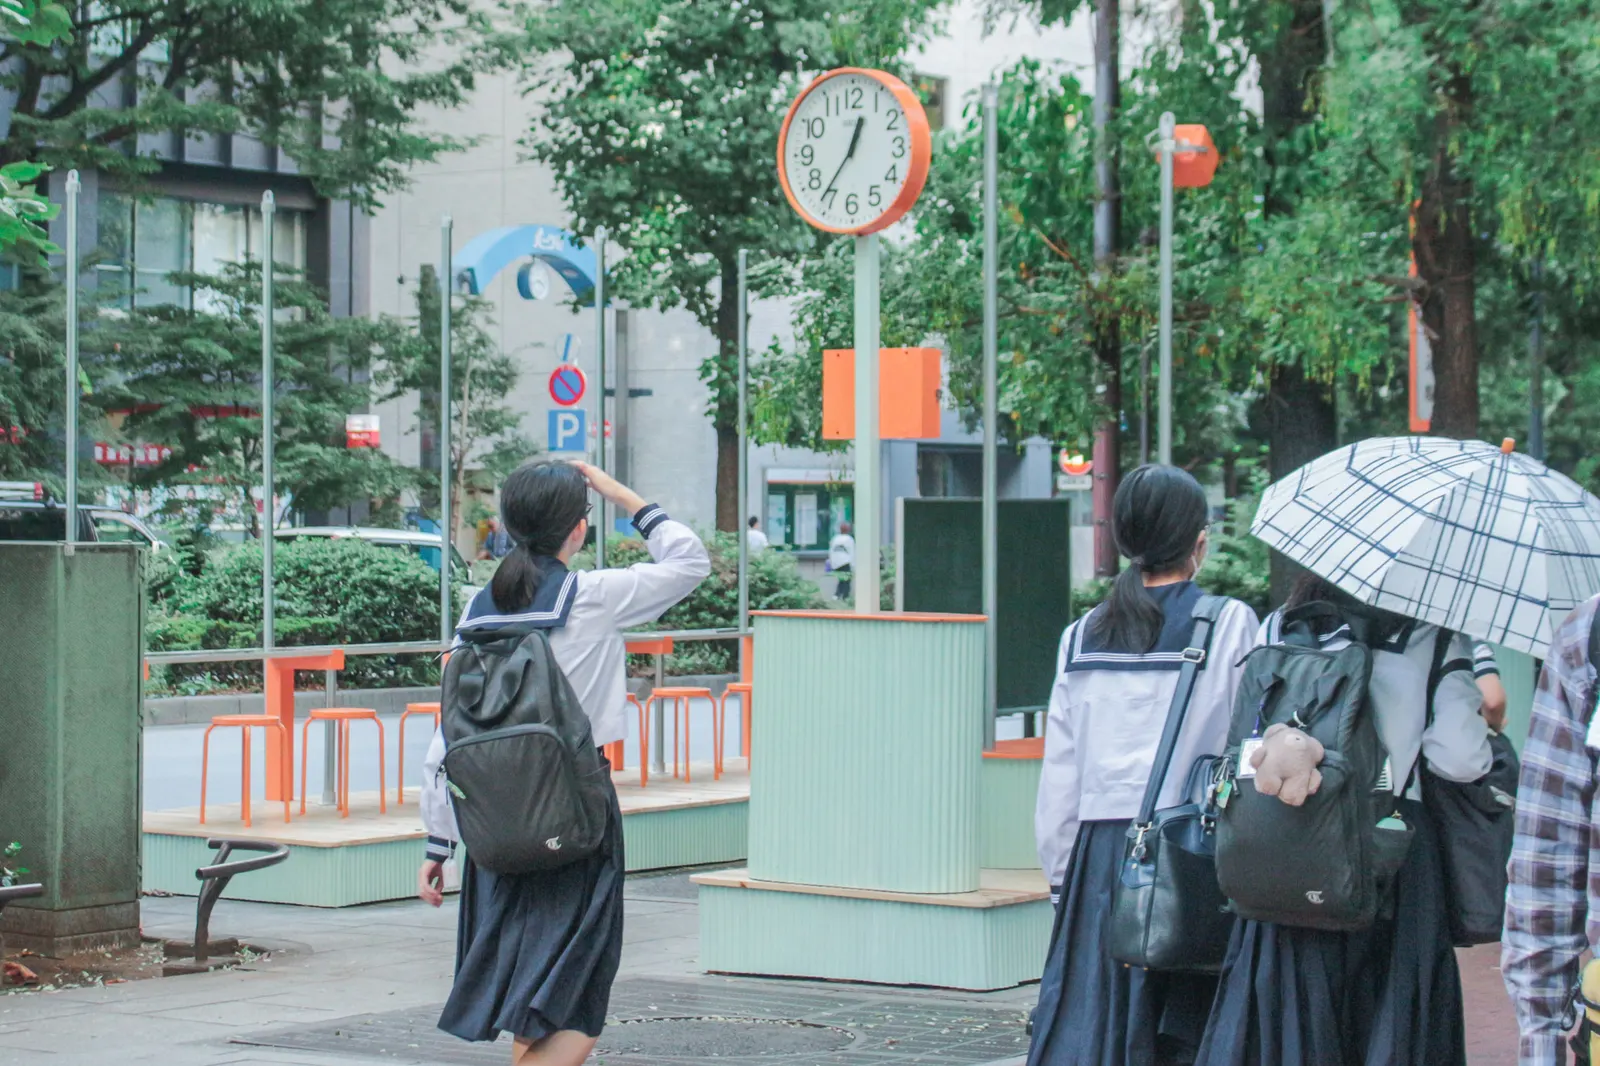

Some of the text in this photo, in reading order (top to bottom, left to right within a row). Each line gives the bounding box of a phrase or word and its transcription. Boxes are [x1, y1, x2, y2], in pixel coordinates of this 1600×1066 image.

[826, 94, 840, 117] 11
[845, 87, 864, 110] 12
[874, 91, 879, 113] 1
[807, 117, 825, 139] 10
[886, 108, 899, 131] 2
[800, 144, 814, 166] 9
[892, 136, 905, 158] 3
[808, 168, 821, 190] 8
[884, 163, 898, 184] 4
[826, 188, 838, 210] 7
[845, 193, 859, 215] 6
[868, 184, 882, 207] 5
[557, 413, 580, 449] P
